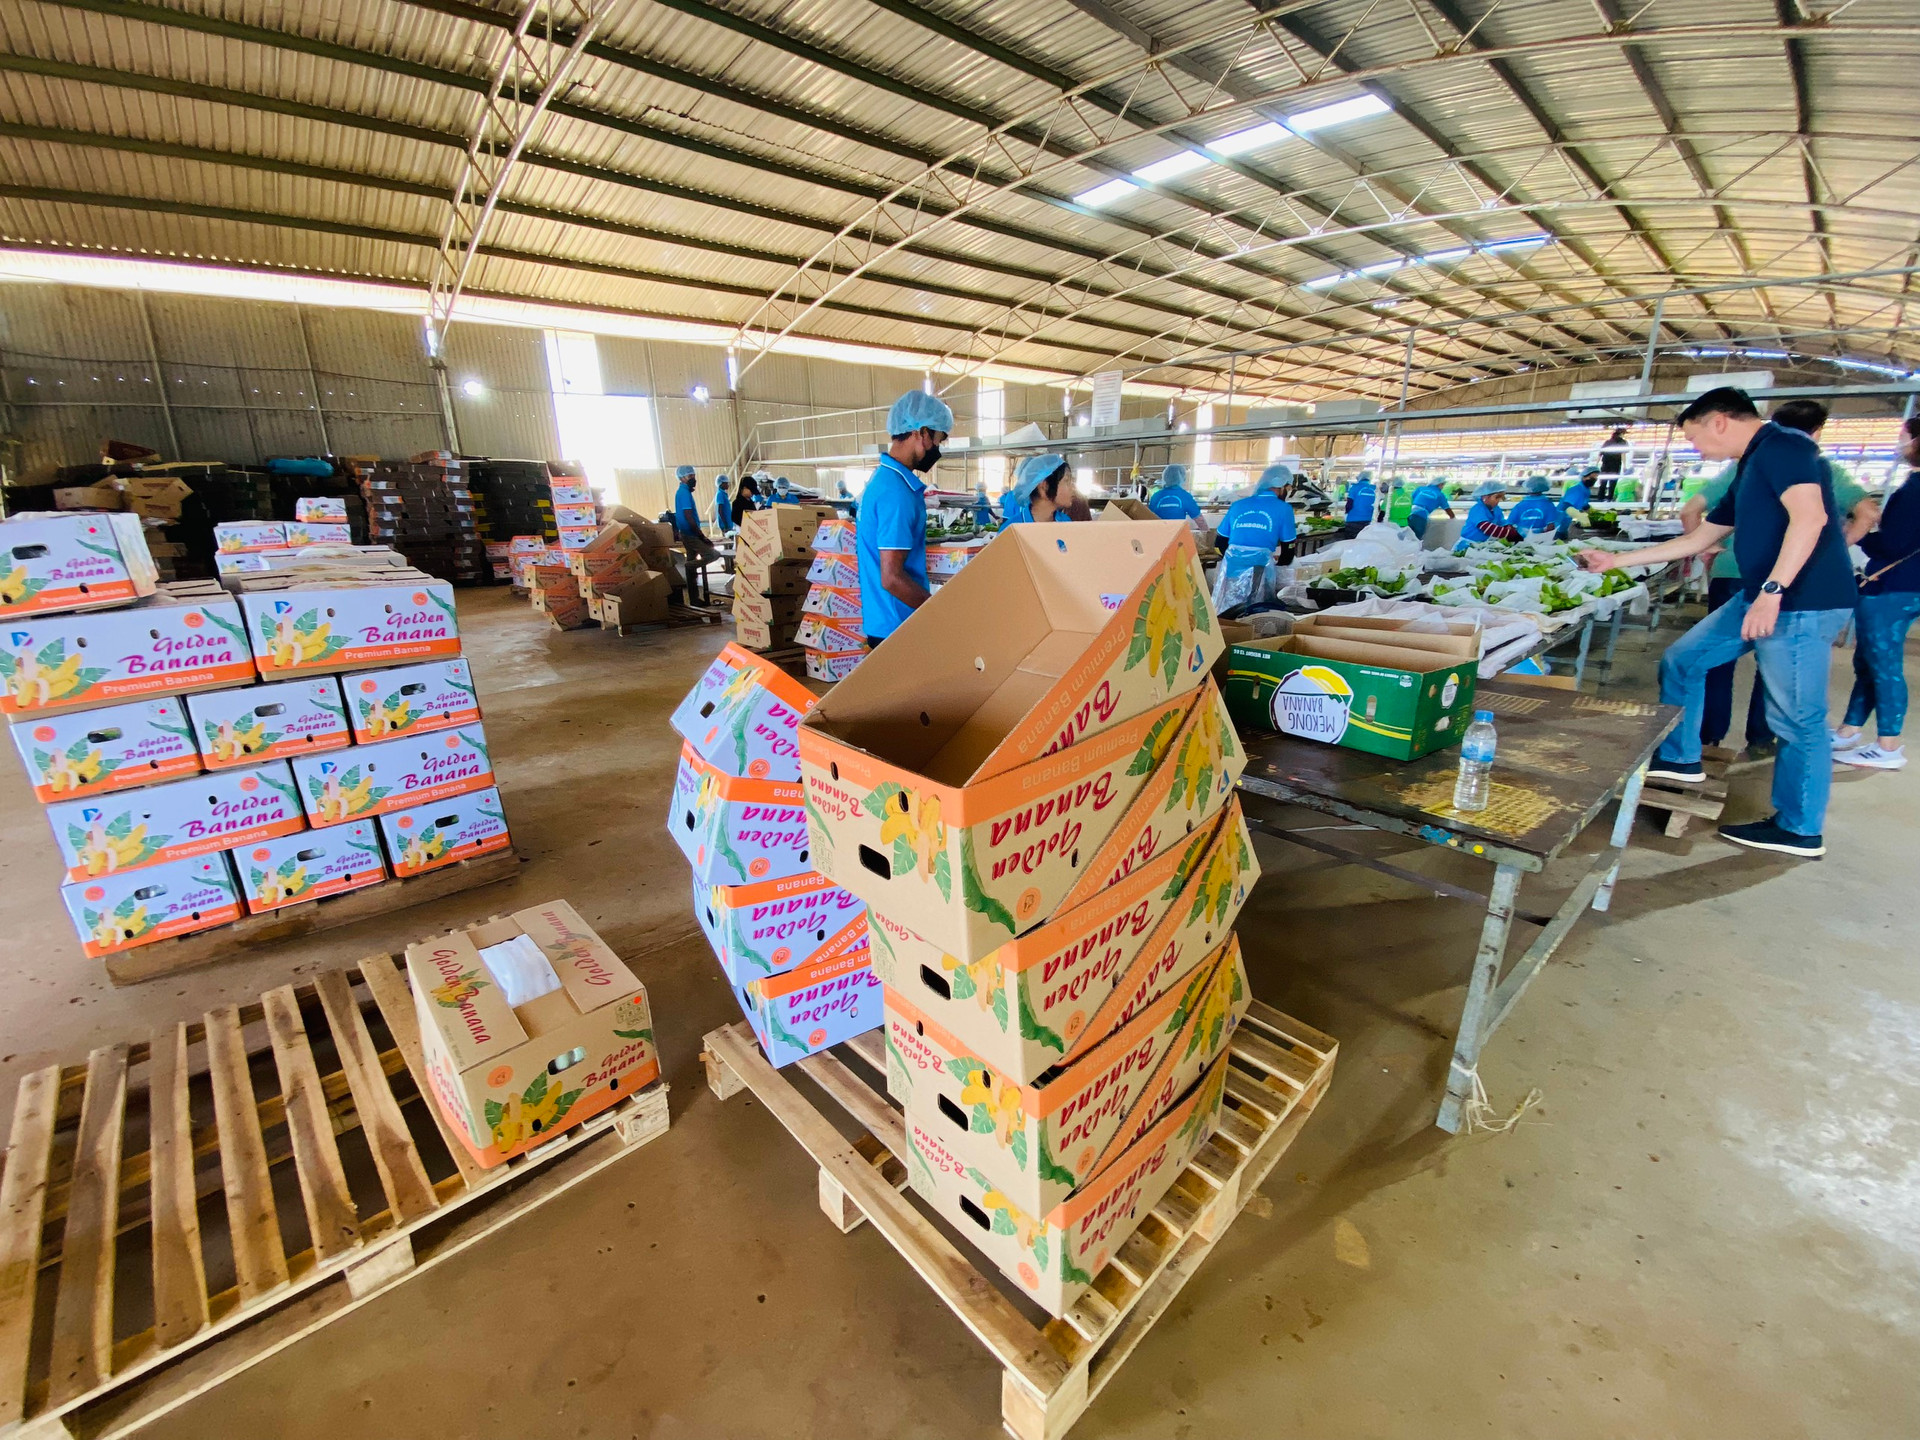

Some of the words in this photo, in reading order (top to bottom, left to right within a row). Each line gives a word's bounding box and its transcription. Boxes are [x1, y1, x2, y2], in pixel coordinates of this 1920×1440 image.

[47, 566, 115, 581] Banana
[66, 557, 111, 570] Golden
[386, 612, 444, 628] Golden
[152, 634, 227, 655] Golden
[358, 627, 446, 643] Banana
[117, 650, 232, 674] Banana
[345, 647, 392, 660] Premium
[394, 644, 431, 655] Banana
[1071, 624, 1127, 692] Premium
[103, 679, 163, 695] Premium
[164, 671, 214, 686] Banana
[423, 698, 469, 711] Banana
[436, 691, 467, 702] Golden
[1283, 695, 1323, 712] BANANA
[281, 720, 336, 734] Banana
[298, 713, 334, 724] Golden
[1018, 691, 1073, 754] Banana
[1288, 712, 1336, 733] MEKONG
[120, 743, 183, 760] Banana
[138, 736, 180, 749] Golden
[1084, 728, 1138, 763] Premium
[423, 752, 476, 772] Golden
[1022, 756, 1080, 789] Banana
[397, 764, 479, 790] Banana
[211, 796, 280, 819] Golden
[387, 791, 430, 807] Premium
[431, 782, 467, 797] Banana
[810, 776, 864, 818] Banana
[812, 794, 847, 821] Golden
[990, 771, 1118, 847] Banana
[179, 808, 284, 838] Banana
[456, 824, 499, 841] Banana
[468, 818, 497, 830] Golden
[166, 839, 221, 858] Premium
[222, 829, 268, 846] Banana
[992, 818, 1082, 880] Golden
[321, 857, 372, 876] Banana
[336, 850, 370, 865] Golden
[181, 887, 221, 902] Golden
[776, 874, 825, 892] Banana
[165, 894, 223, 914] Banana
[752, 888, 861, 922] Banana
[753, 911, 827, 941] Golden
[876, 911, 909, 941] Golden
[815, 928, 857, 964] Banana
[1042, 900, 1154, 984] Banana
[810, 960, 855, 979] Banana
[1044, 947, 1122, 1012] Golden
[427, 949, 464, 990] Golden
[454, 987, 491, 1044] Banana
[790, 992, 859, 1025] Golden
[601, 1041, 644, 1068] Golden
[892, 1021, 946, 1074] Banana
[893, 1036, 928, 1069] Golden
[581, 1050, 645, 1087] Banana
[1059, 1037, 1158, 1128] Banana
[1059, 1084, 1129, 1153] Golden
[914, 1126, 968, 1180] Banana
[914, 1139, 950, 1172] Golden
[1080, 1144, 1169, 1235] Banana
[1080, 1188, 1142, 1255] Golden
